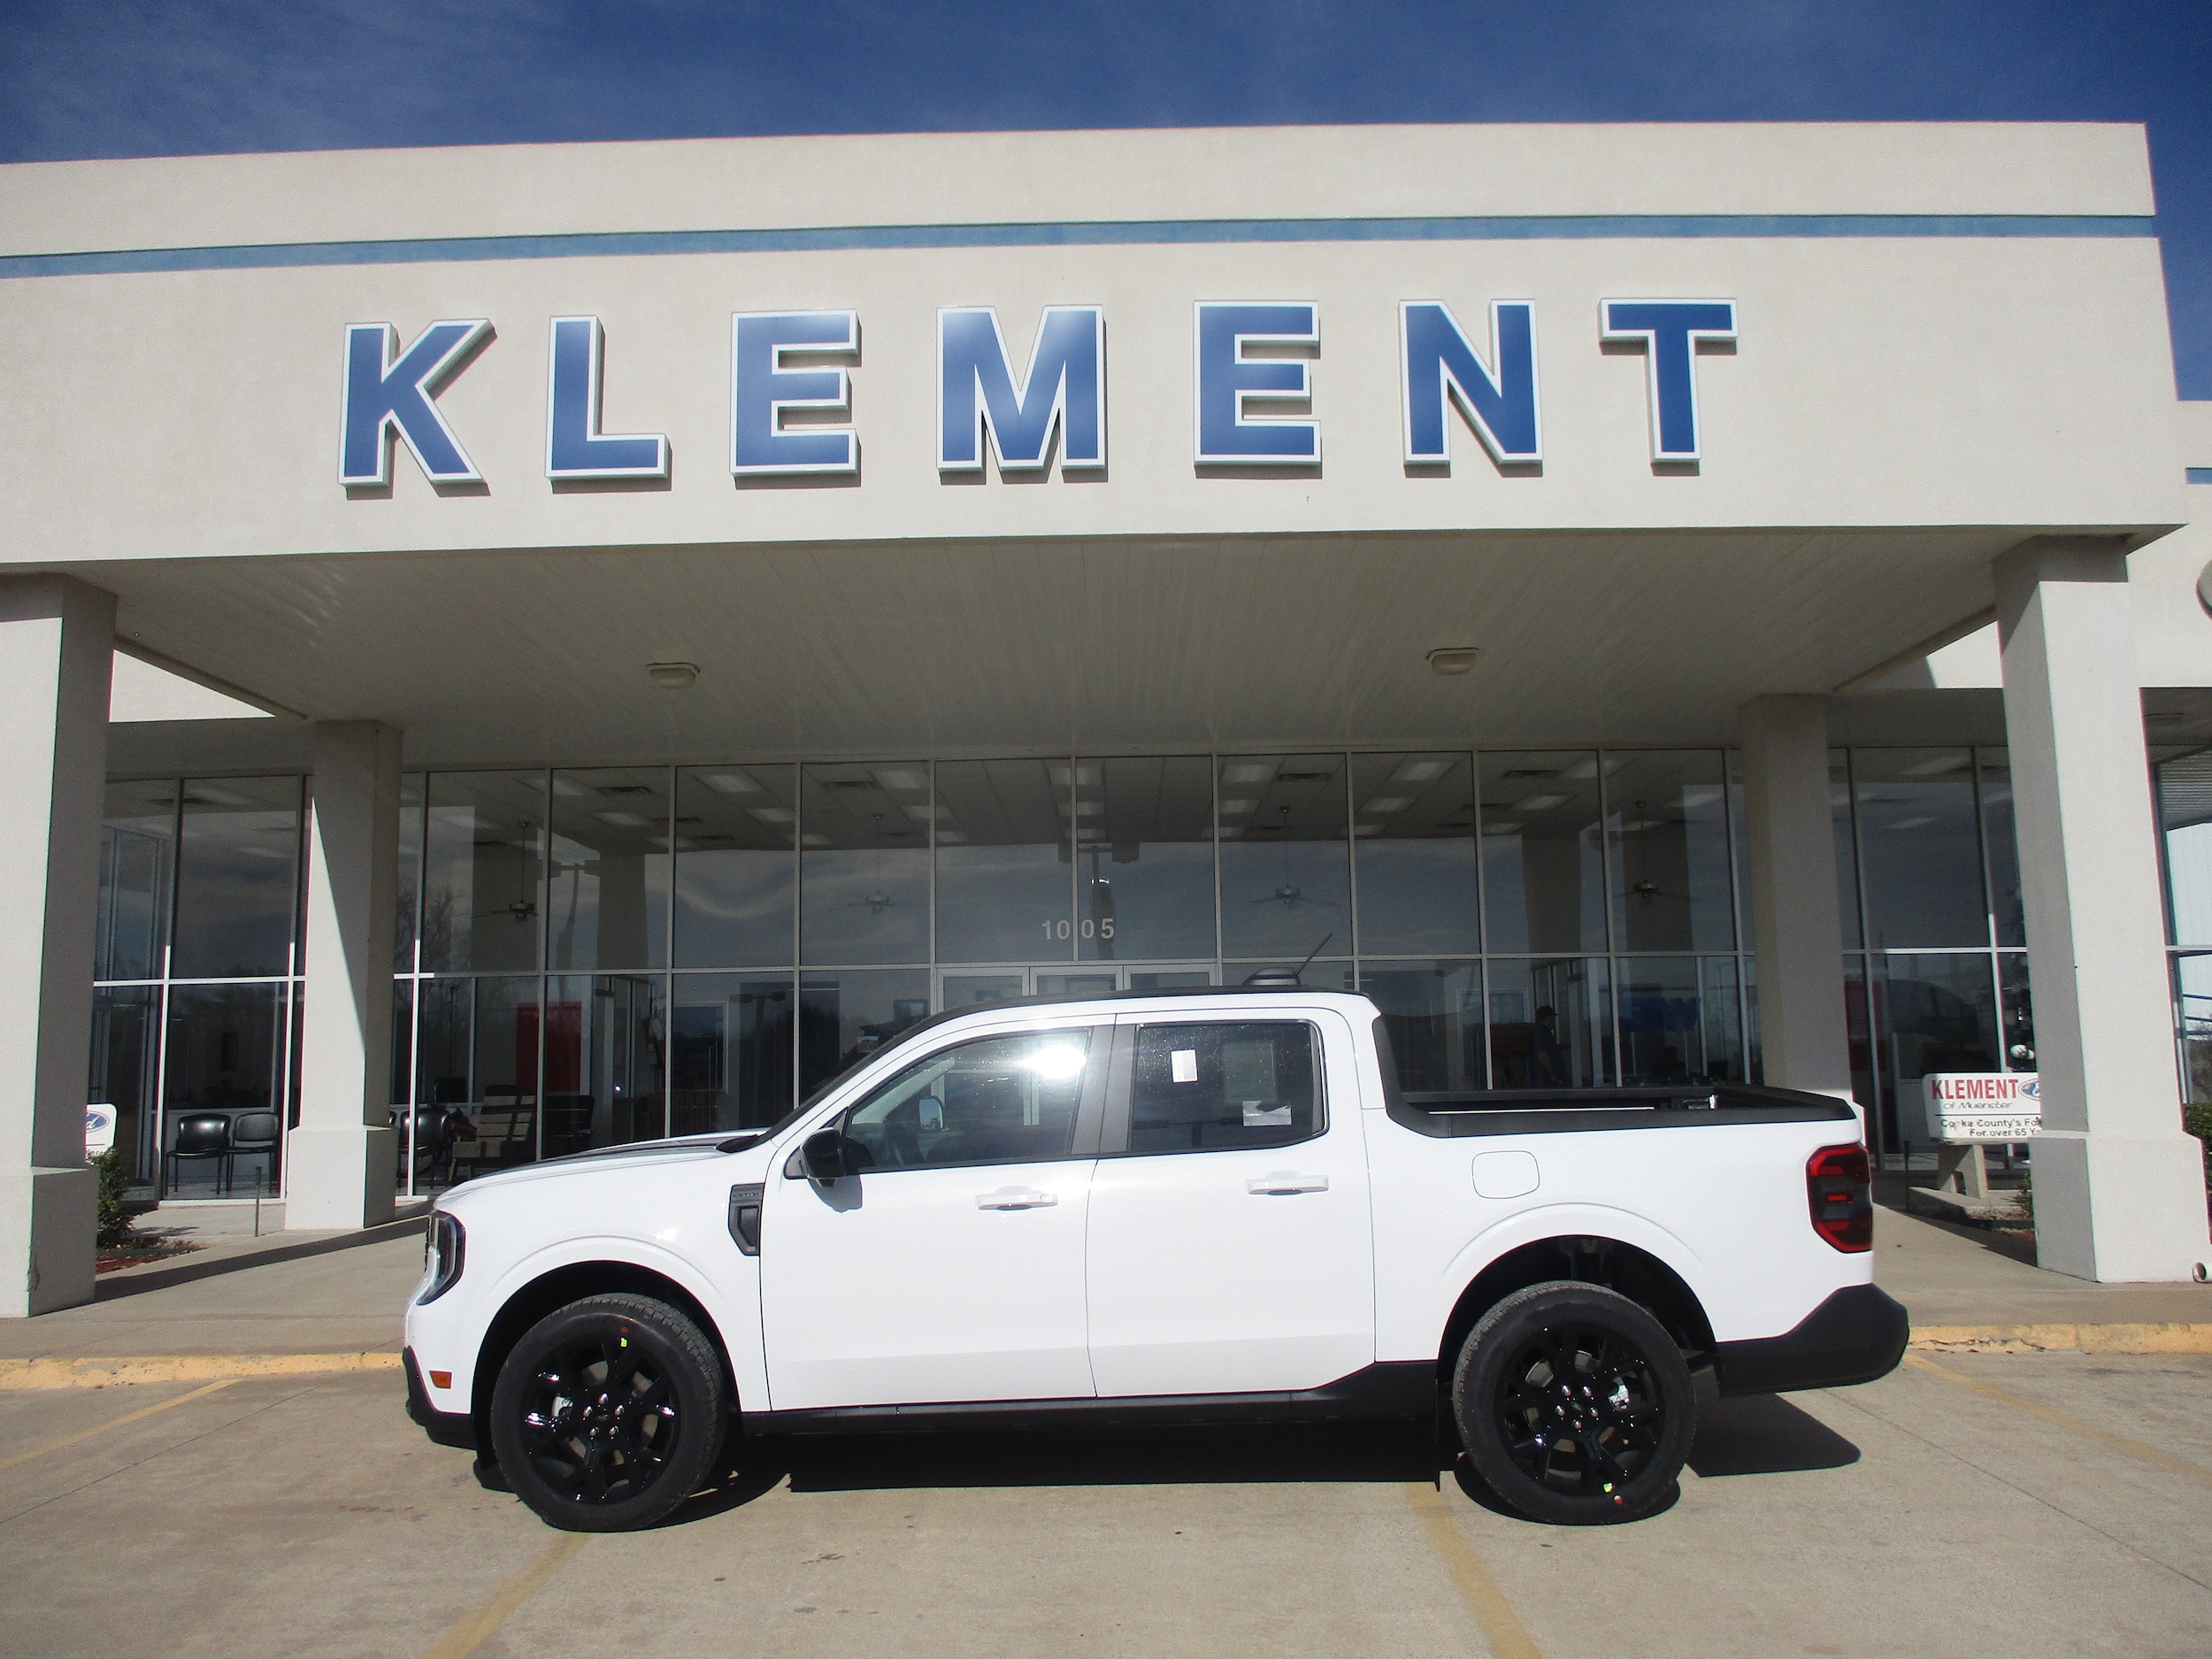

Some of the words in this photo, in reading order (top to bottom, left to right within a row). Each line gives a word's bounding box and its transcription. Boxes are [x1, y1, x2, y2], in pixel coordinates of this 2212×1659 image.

[338, 298, 1738, 491] KLEMENT
[1041, 918, 1115, 940] 1005
[1932, 1079, 2018, 1099] KLEMENT
[1943, 1101, 1955, 1110] of
[1958, 1101, 2012, 1110] Muenster
[1940, 1118, 1973, 1127] Coke
[1977, 1118, 2021, 1129] County's
